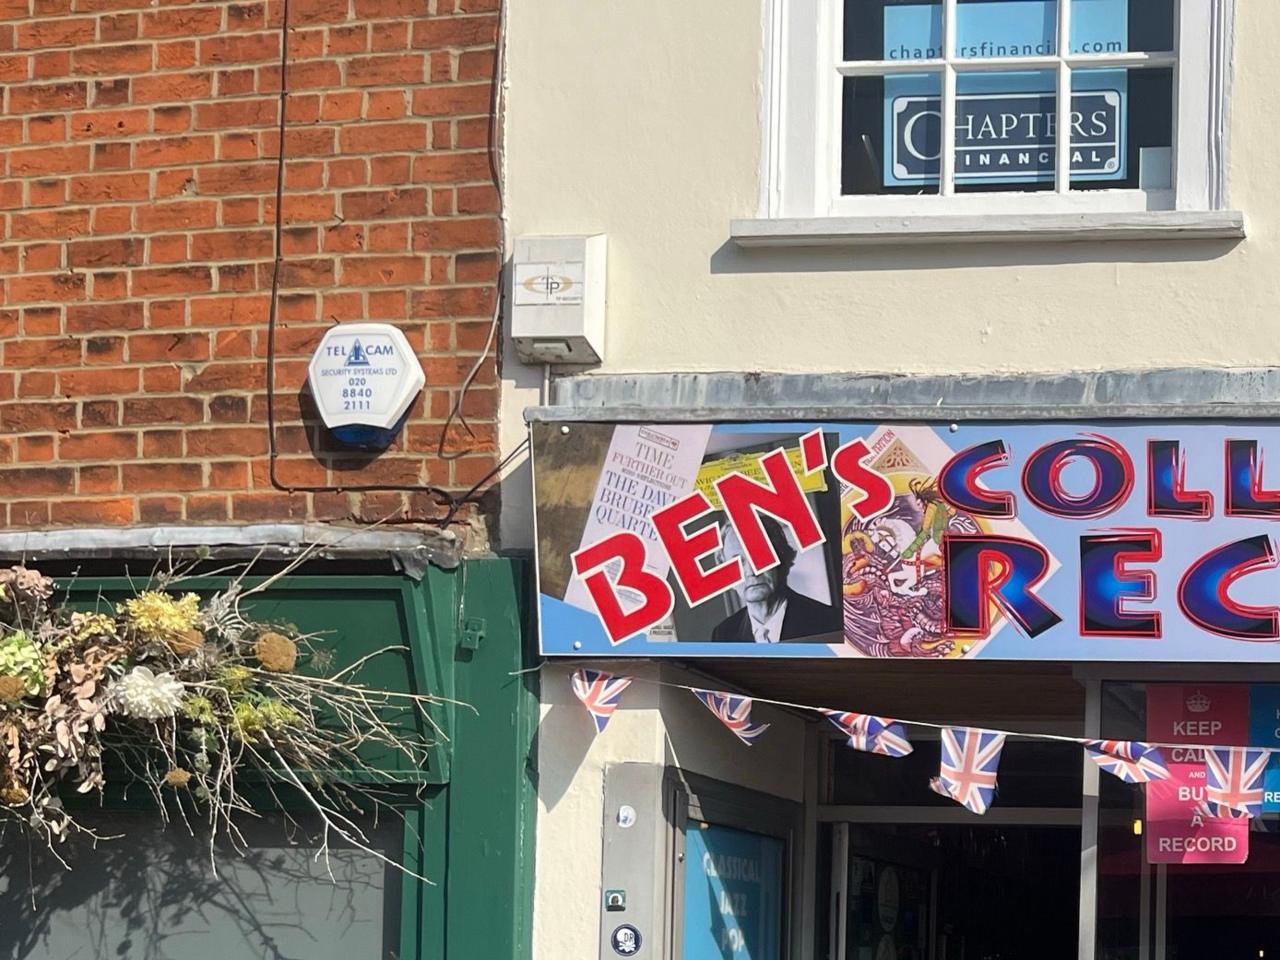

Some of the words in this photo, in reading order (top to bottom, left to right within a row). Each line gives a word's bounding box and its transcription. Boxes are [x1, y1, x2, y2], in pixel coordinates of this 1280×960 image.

[326, 346, 347, 356] TEL
[365, 345, 394, 355] CAM
[321, 368, 352, 377] SECURITY
[353, 368, 384, 376] SYSTEMS
[385, 368, 398, 376] LTD
[348, 377, 367, 386] 020
[342, 388, 372, 398] 8840
[344, 400, 371, 411] 2111
[636, 442, 675, 470] TIME
[606, 469, 639, 496] THE
[571, 427, 896, 647] BEN'S
[1173, 721, 1222, 736] KEEP
[1171, 749, 1207, 763] CAL
[1178, 786, 1209, 802] BU
[1191, 815, 1204, 828] A
[1159, 837, 1237, 852] RECORD
